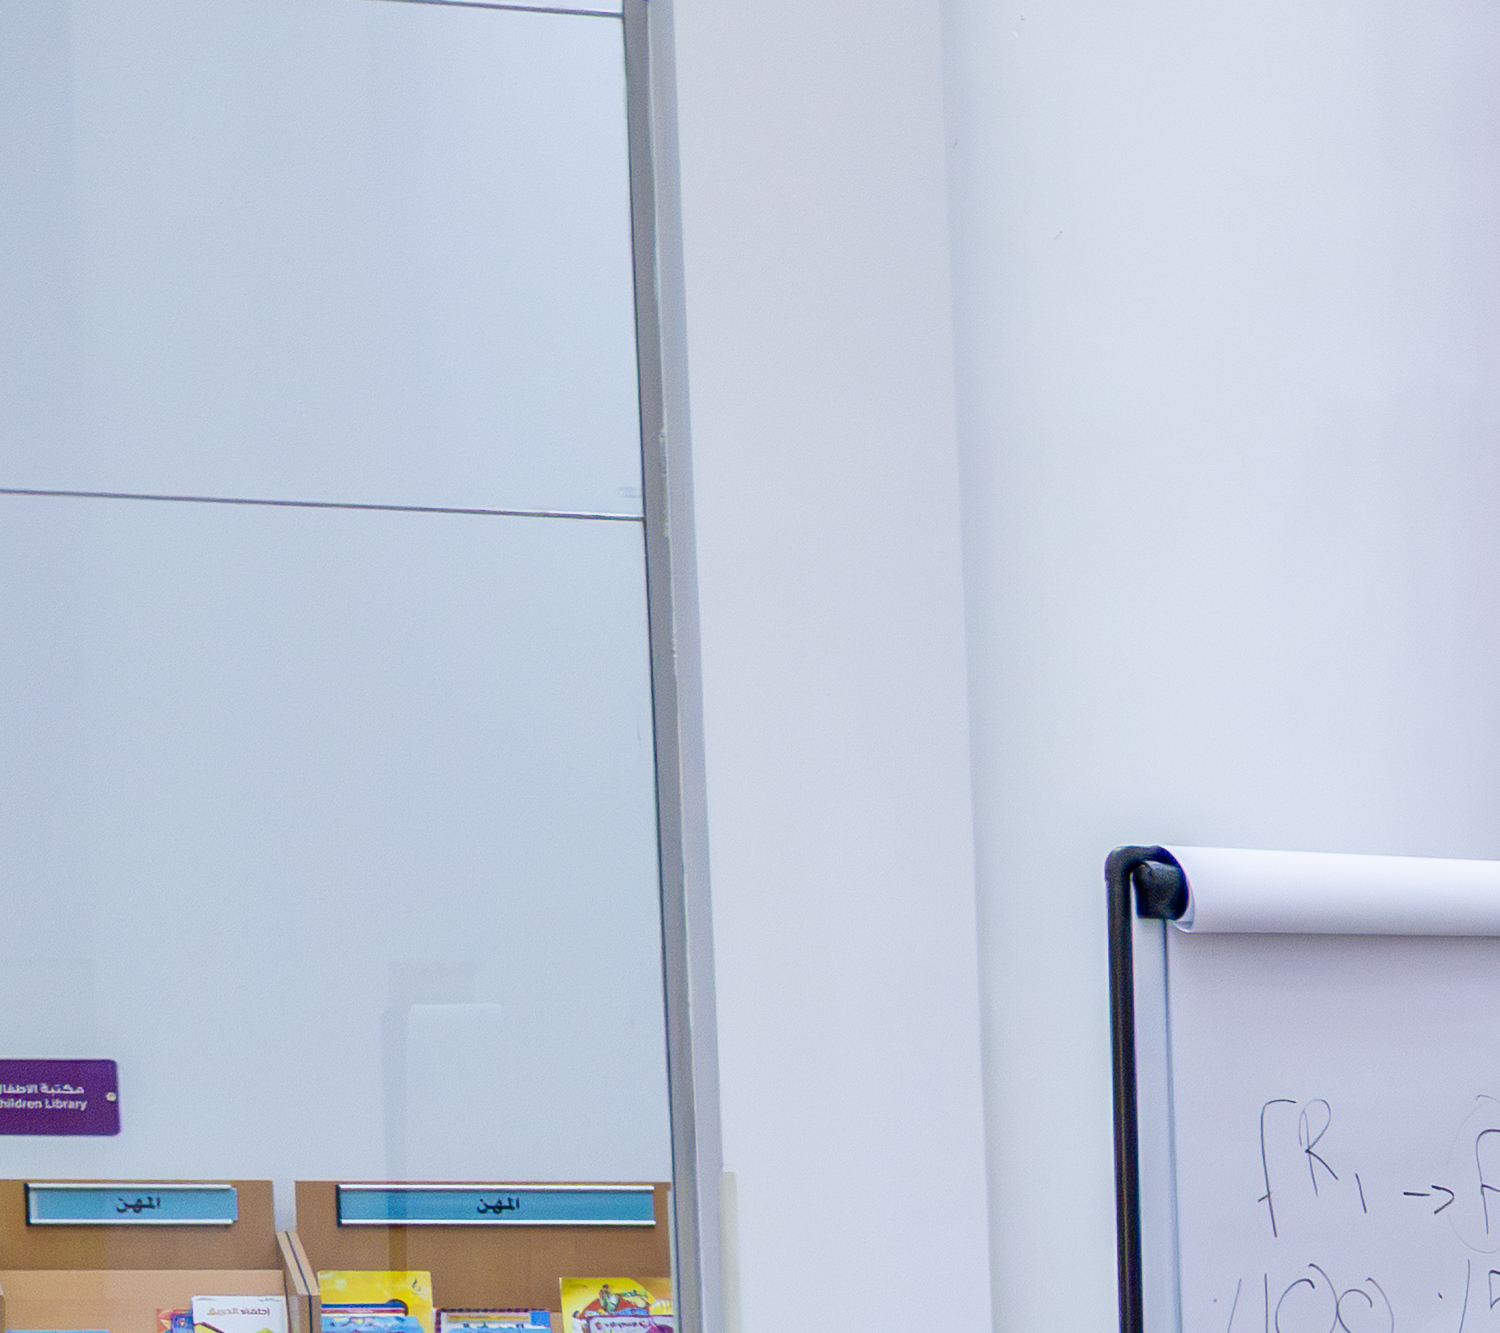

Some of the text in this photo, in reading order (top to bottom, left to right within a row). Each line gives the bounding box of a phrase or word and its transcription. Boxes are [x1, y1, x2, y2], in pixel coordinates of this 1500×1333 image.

[40, 1083, 85, 1097] مكتبة
[45, 1098, 88, 1111] Library
[115, 1194, 161, 1214] المهن
[476, 1195, 520, 1215] المهن
